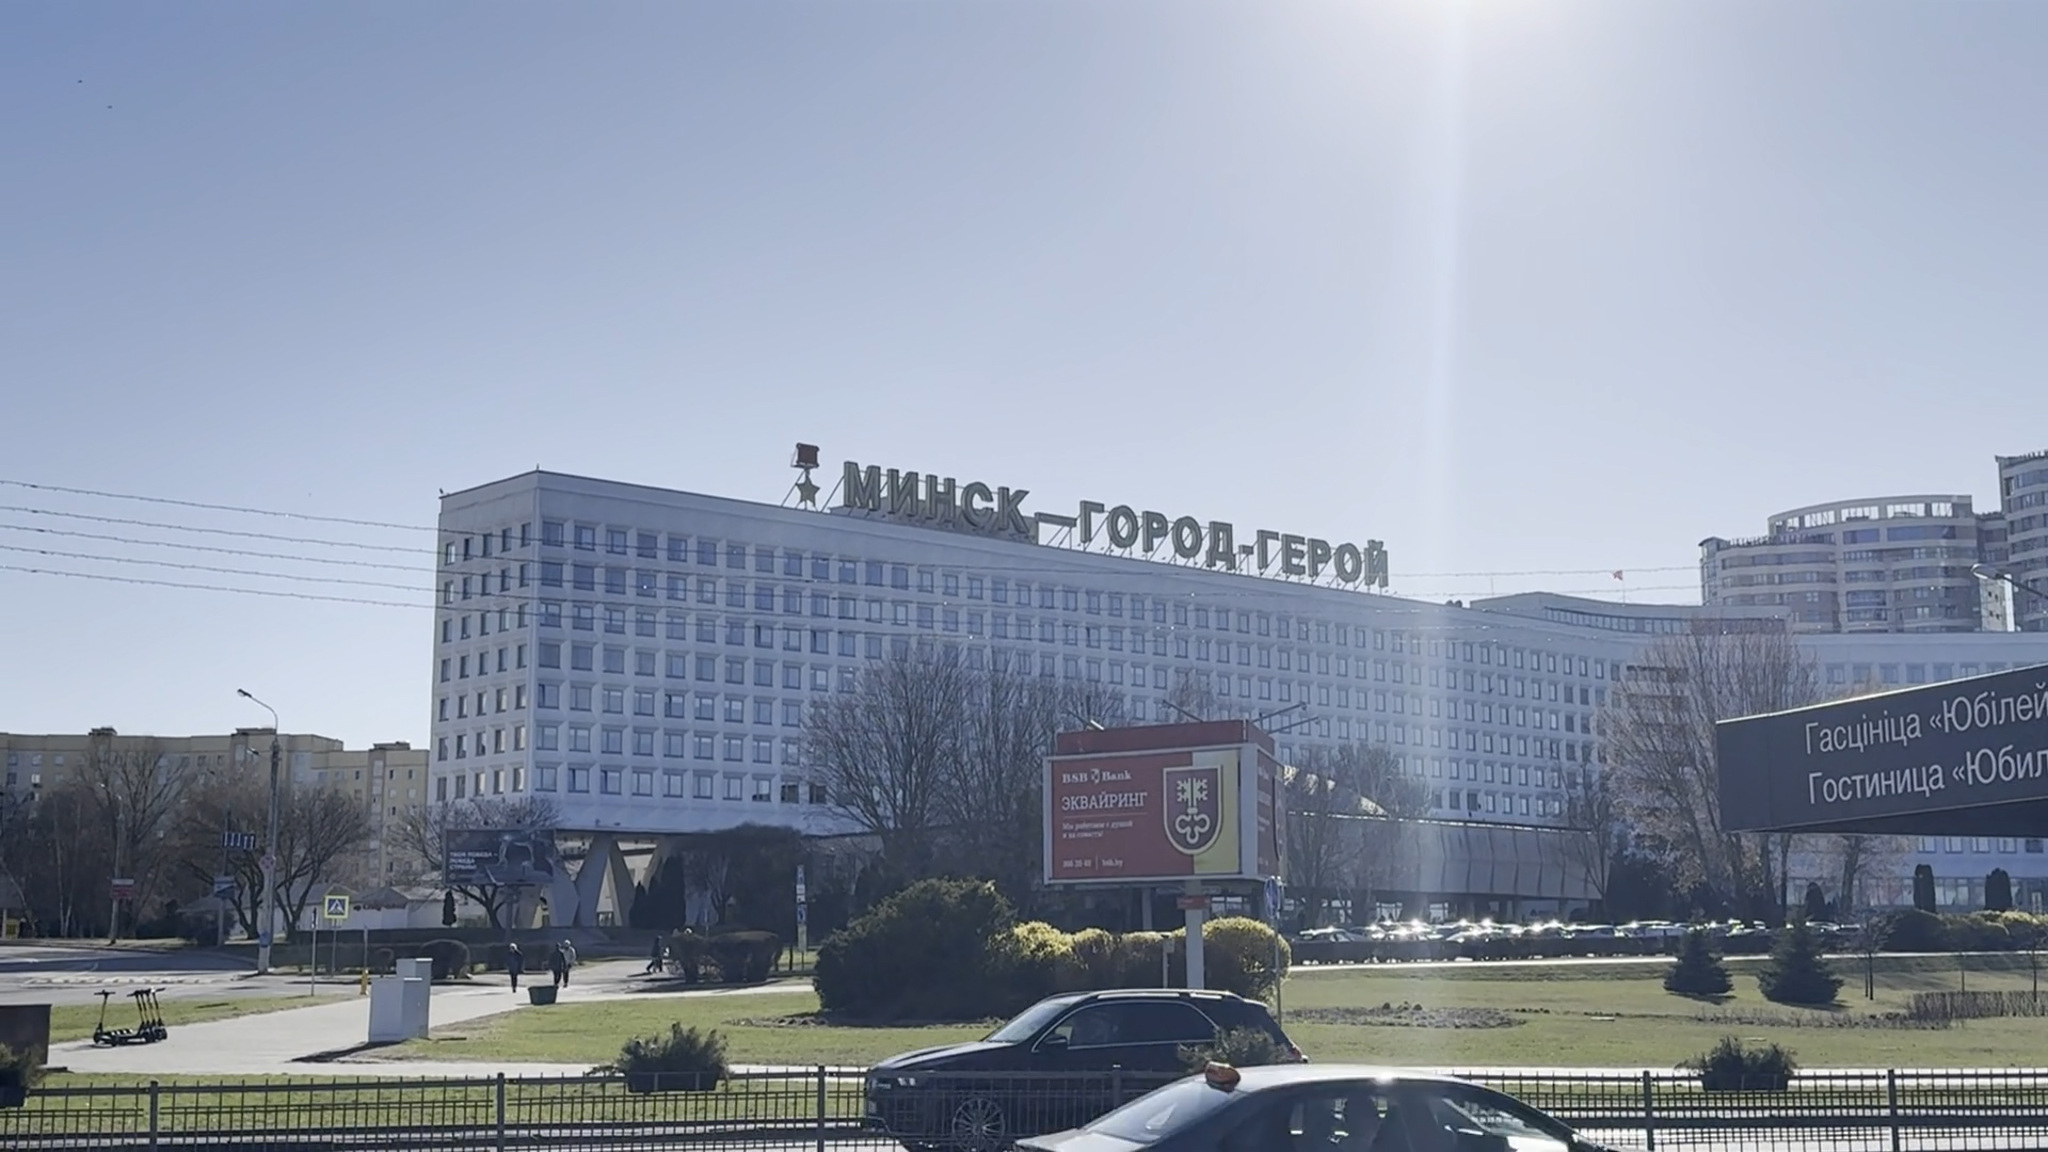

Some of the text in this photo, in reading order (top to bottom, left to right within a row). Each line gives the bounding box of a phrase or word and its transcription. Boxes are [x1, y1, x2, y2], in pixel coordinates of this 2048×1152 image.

[1805, 710, 1922, 754] Гасцініца
[1062, 769, 1132, 783] BSB Bank
[1808, 763, 1945, 804] Гостиница
[1061, 791, 1148, 811] ЭКВАЙРИНГ
